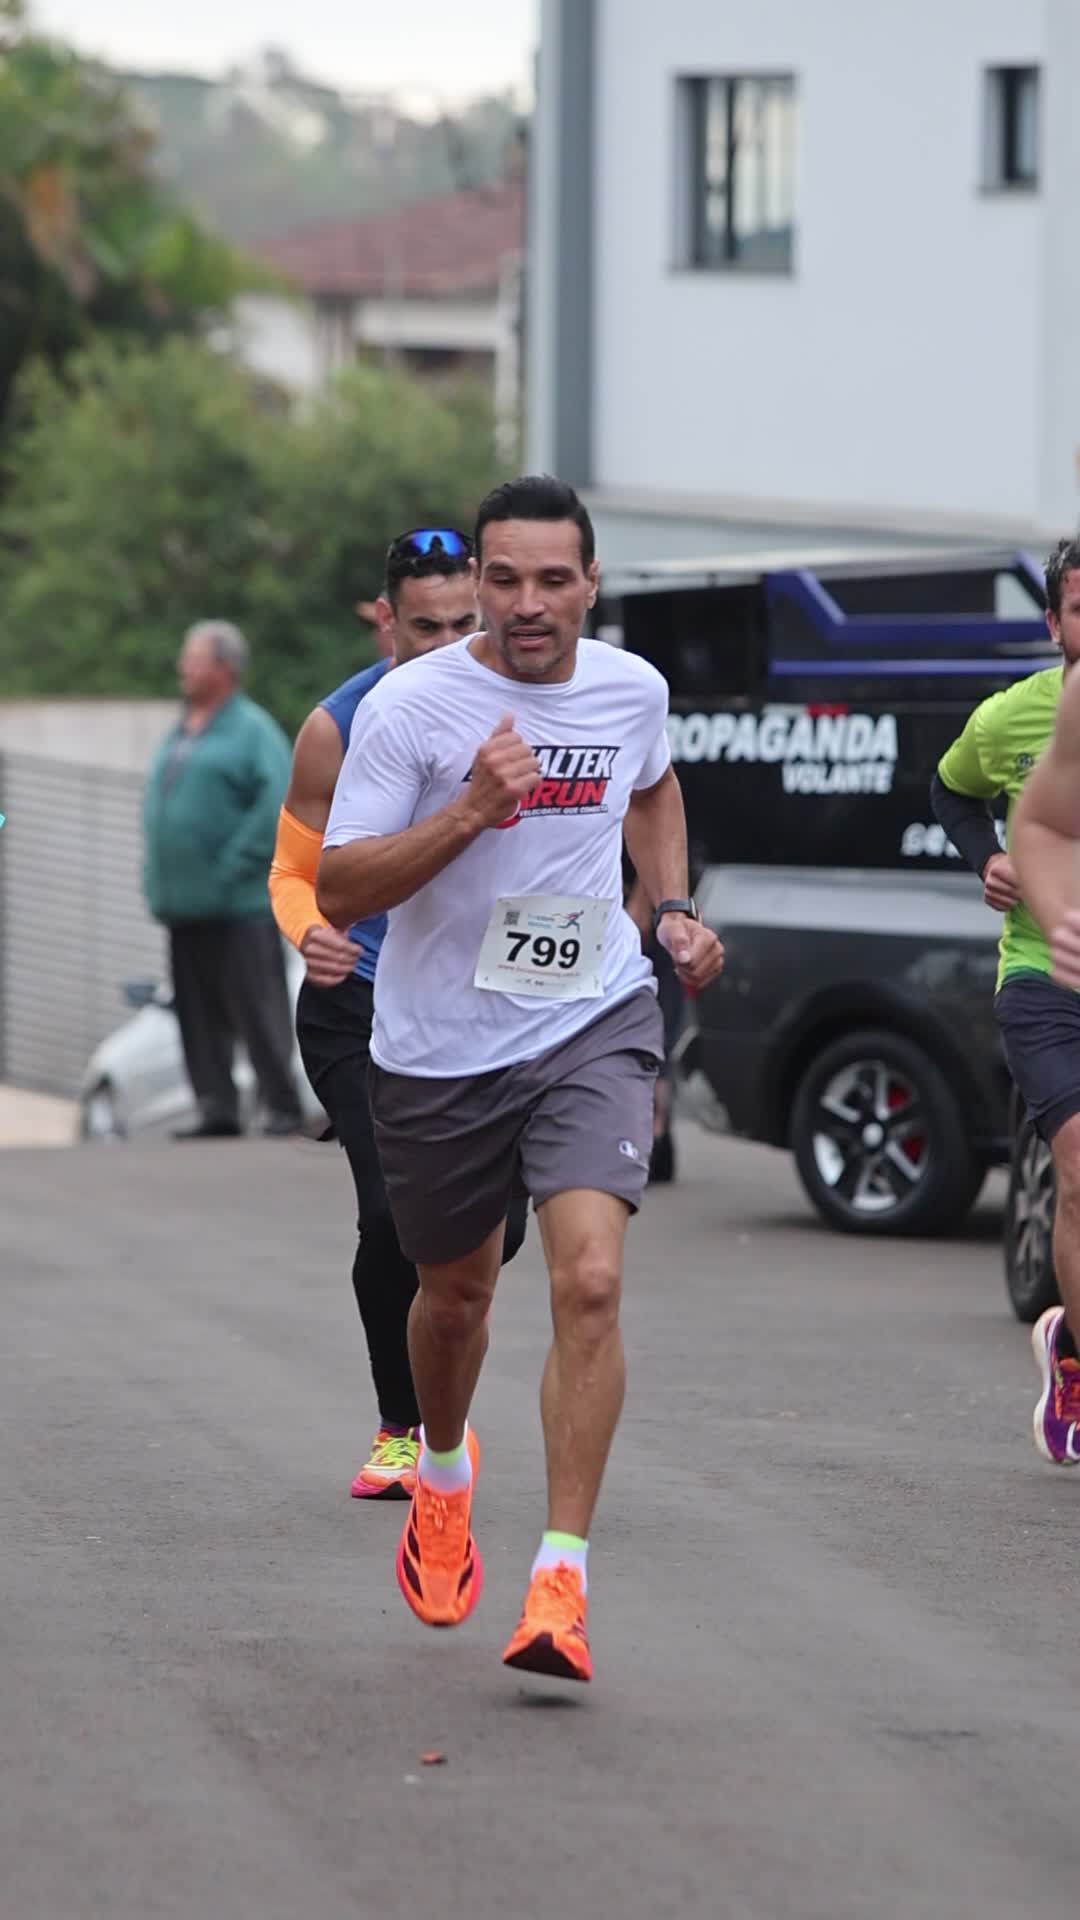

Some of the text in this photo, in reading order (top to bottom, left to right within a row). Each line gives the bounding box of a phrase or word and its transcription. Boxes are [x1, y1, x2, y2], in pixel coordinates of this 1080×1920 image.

[668, 713, 898, 761] ROPAGANDA
[532, 747, 616, 778] ALTEK
[782, 762, 894, 793] VOLANTE
[506, 931, 580, 969] 799
